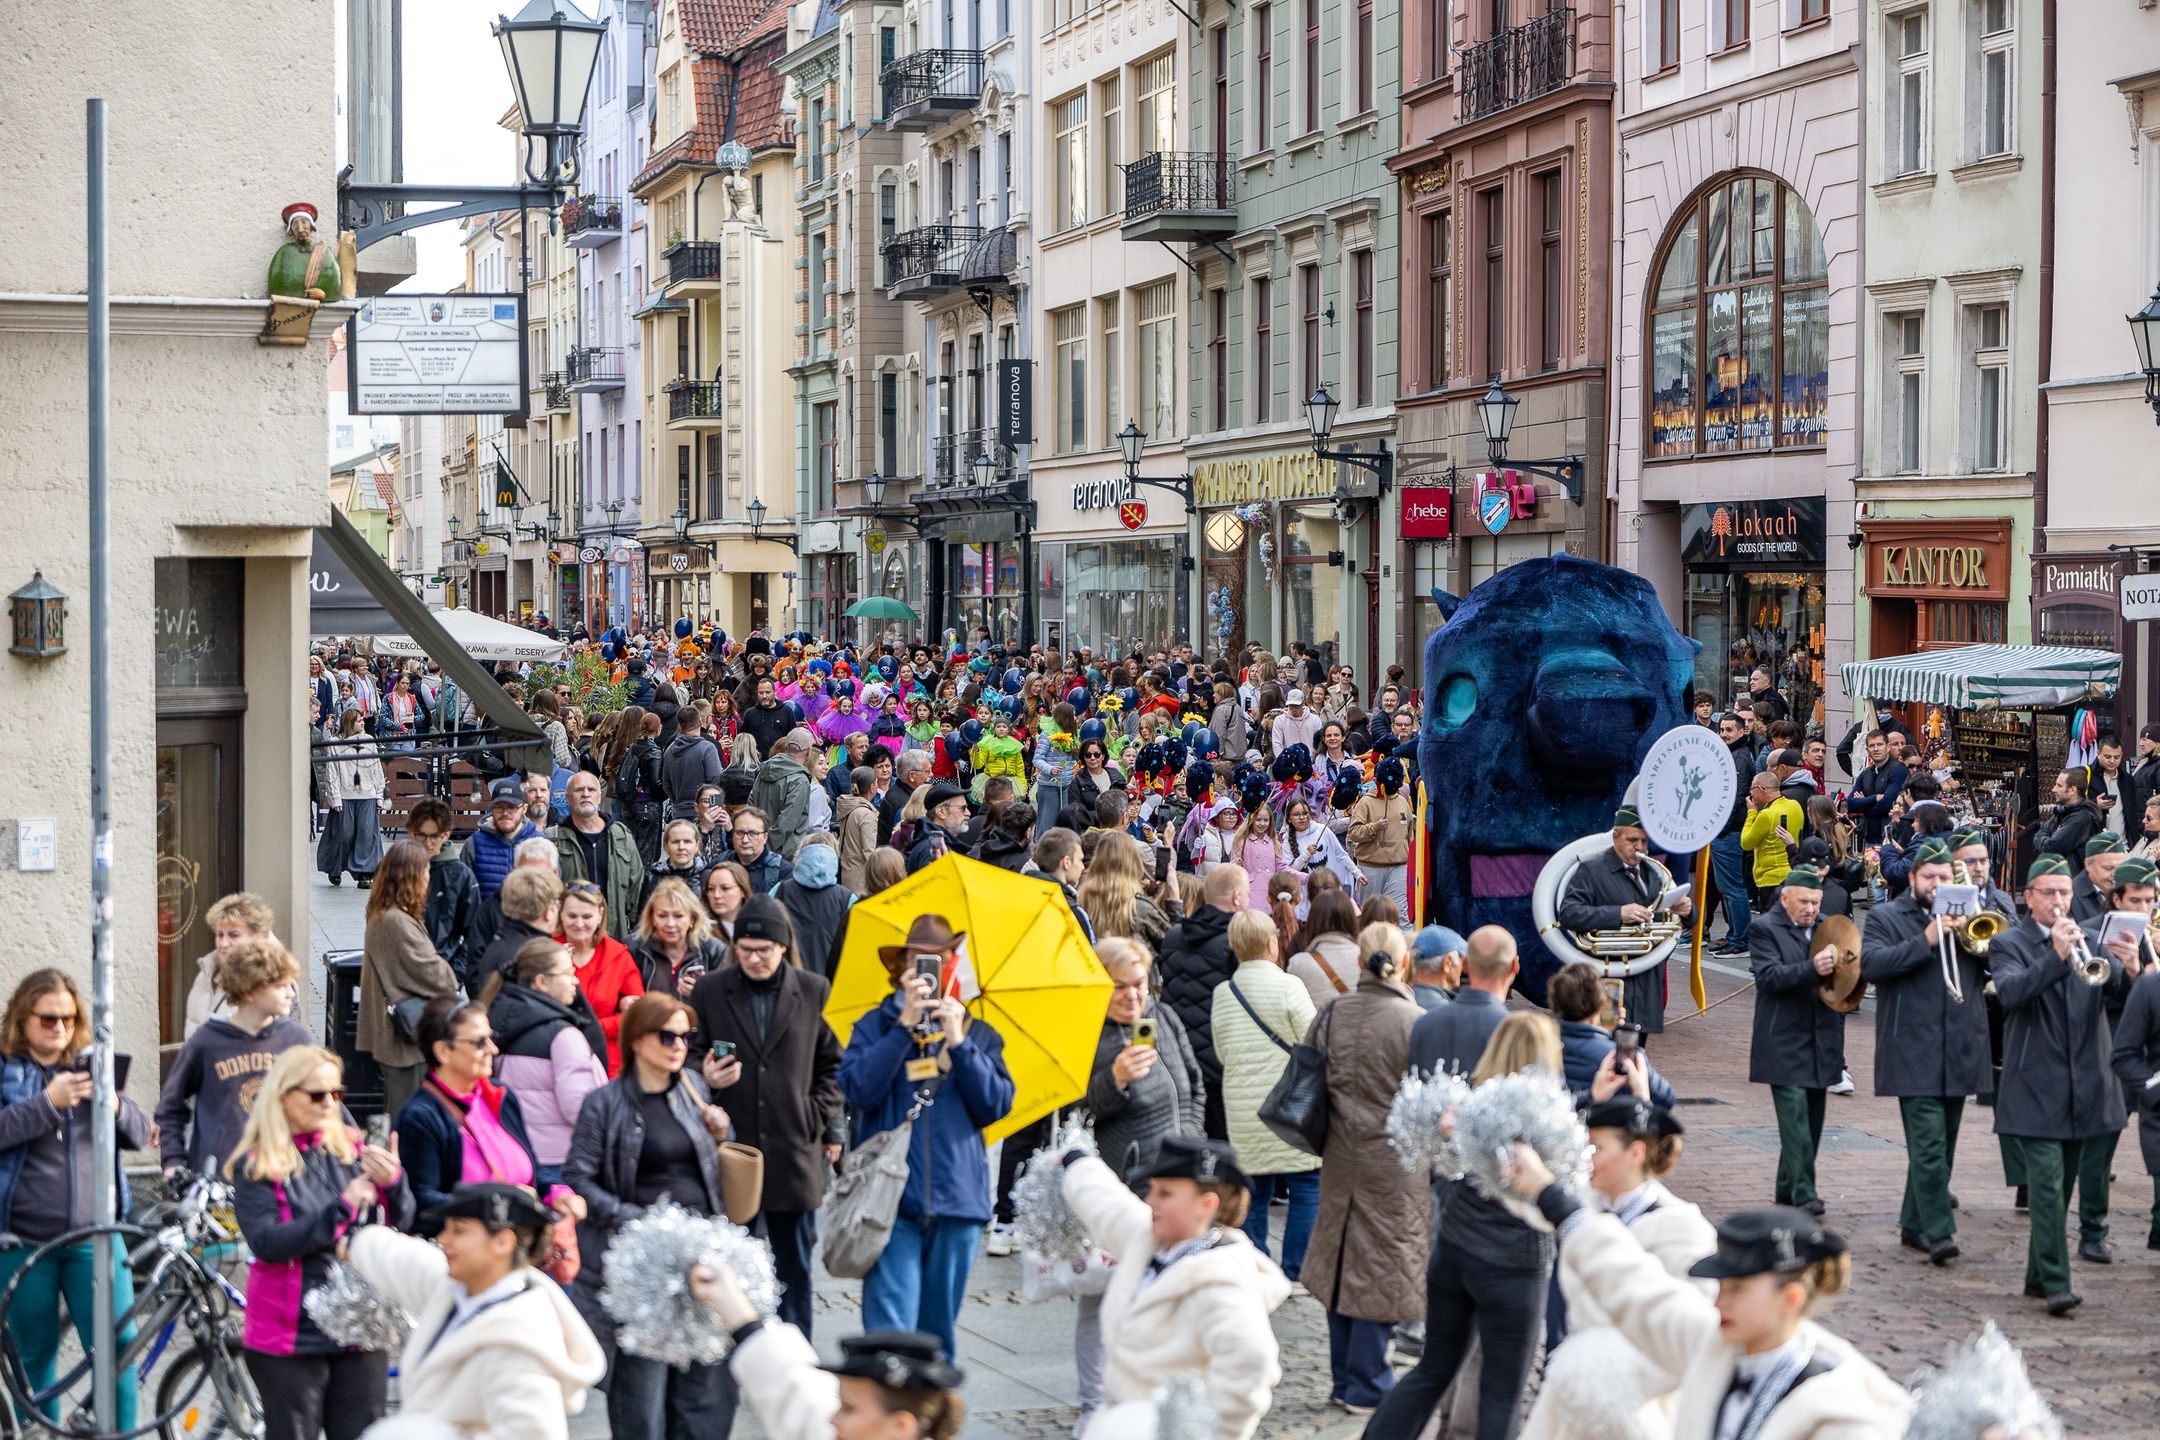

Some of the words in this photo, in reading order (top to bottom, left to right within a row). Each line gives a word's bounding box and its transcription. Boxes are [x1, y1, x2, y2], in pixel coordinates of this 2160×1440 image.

[1204, 459, 1251, 503] KAISER
[1256, 451, 1337, 499] PATISSERIE
[1413, 503, 1447, 517] hebe
[1735, 507, 1797, 537] Lokaah
[1737, 543, 1756, 553] GOODS
[1757, 543, 1765, 553] OF
[1765, 542, 1776, 552] THE
[1777, 541, 1797, 552] WORLD
[1882, 546, 1989, 587] KANTOR
[2046, 564, 2114, 593] Pamiątki
[2126, 588, 2160, 605] NOT
[465, 645, 489, 654] KAWA
[514, 647, 546, 656] DESERY
[214, 1051, 278, 1081] DONOS
